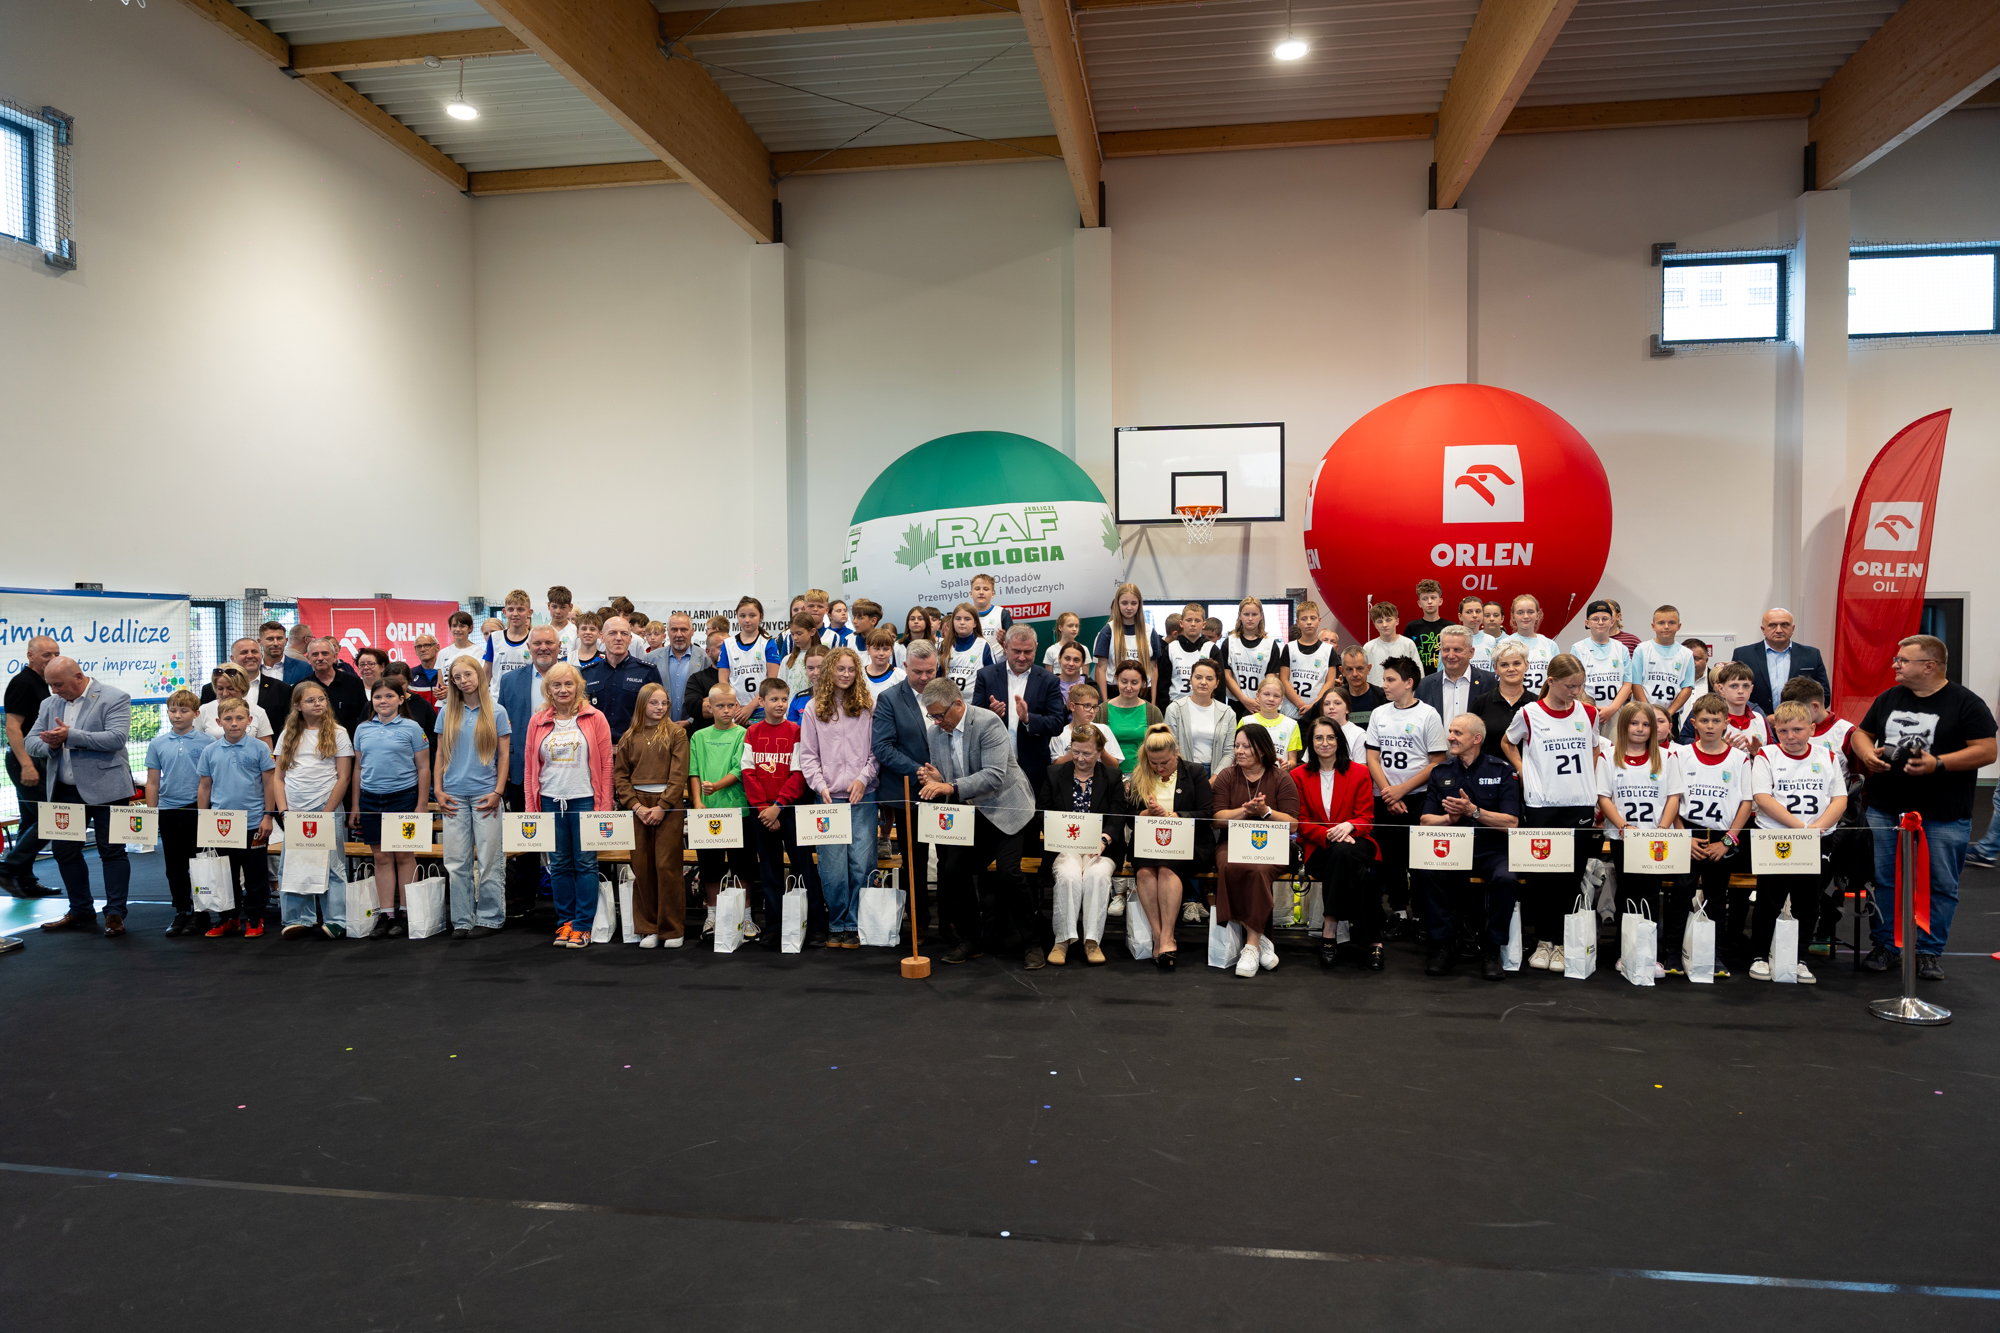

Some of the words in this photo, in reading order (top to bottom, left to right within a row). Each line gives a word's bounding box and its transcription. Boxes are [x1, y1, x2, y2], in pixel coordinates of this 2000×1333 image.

[936, 511, 1058, 549] RAF
[942, 546, 1064, 570] EKOLOGIA
[1430, 542, 1534, 567] ORLEN
[1853, 561, 1924, 577] ORLEN
[994, 572, 1041, 586] Odpadów
[1462, 574, 1498, 591] OIL
[1873, 581, 1899, 592] OIL
[1006, 582, 1064, 596] Medycznych
[84, 618, 170, 644] Jedlicze
[386, 622, 436, 641] ORLEN
[388, 648, 406, 662] OIL
[102, 657, 157, 676] imprezy
[744, 677, 756, 692] 6
[1239, 675, 1258, 691] 30
[1293, 681, 1312, 697] 32
[1524, 674, 1543, 688] 52
[1594, 685, 1617, 701] 50
[1652, 684, 1675, 700] 49
[1544, 742, 1586, 752] JEDLICZE
[1382, 751, 1407, 769] 68
[1556, 754, 1582, 775] 21
[1618, 790, 1659, 798] JEDLICZE
[1778, 783, 1823, 791] JEDLICZE
[1624, 802, 1653, 822] 22
[1688, 800, 1722, 822] 24
[1787, 795, 1818, 814] 23
